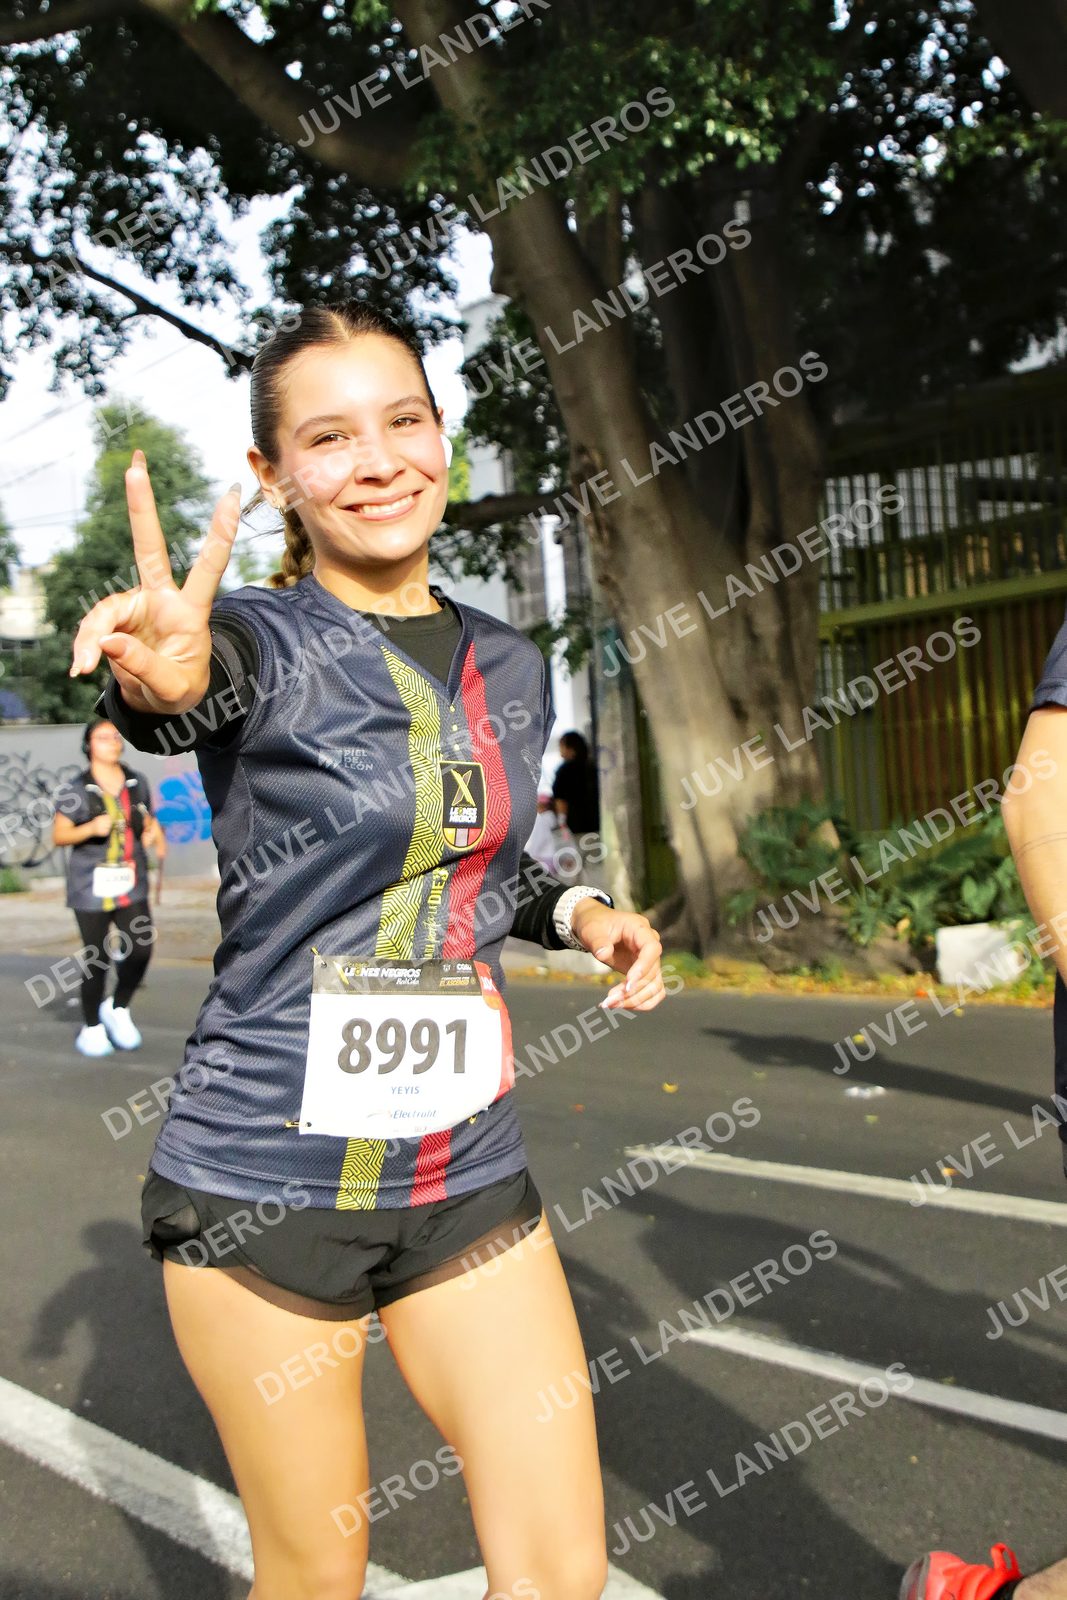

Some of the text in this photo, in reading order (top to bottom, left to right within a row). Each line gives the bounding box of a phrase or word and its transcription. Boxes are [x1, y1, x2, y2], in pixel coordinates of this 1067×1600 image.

[344, 749, 368, 757] PIEL
[381, 968, 421, 978] NEGROS
[338, 1018, 467, 1075] 8991
[391, 1086, 420, 1095] YEYIS
